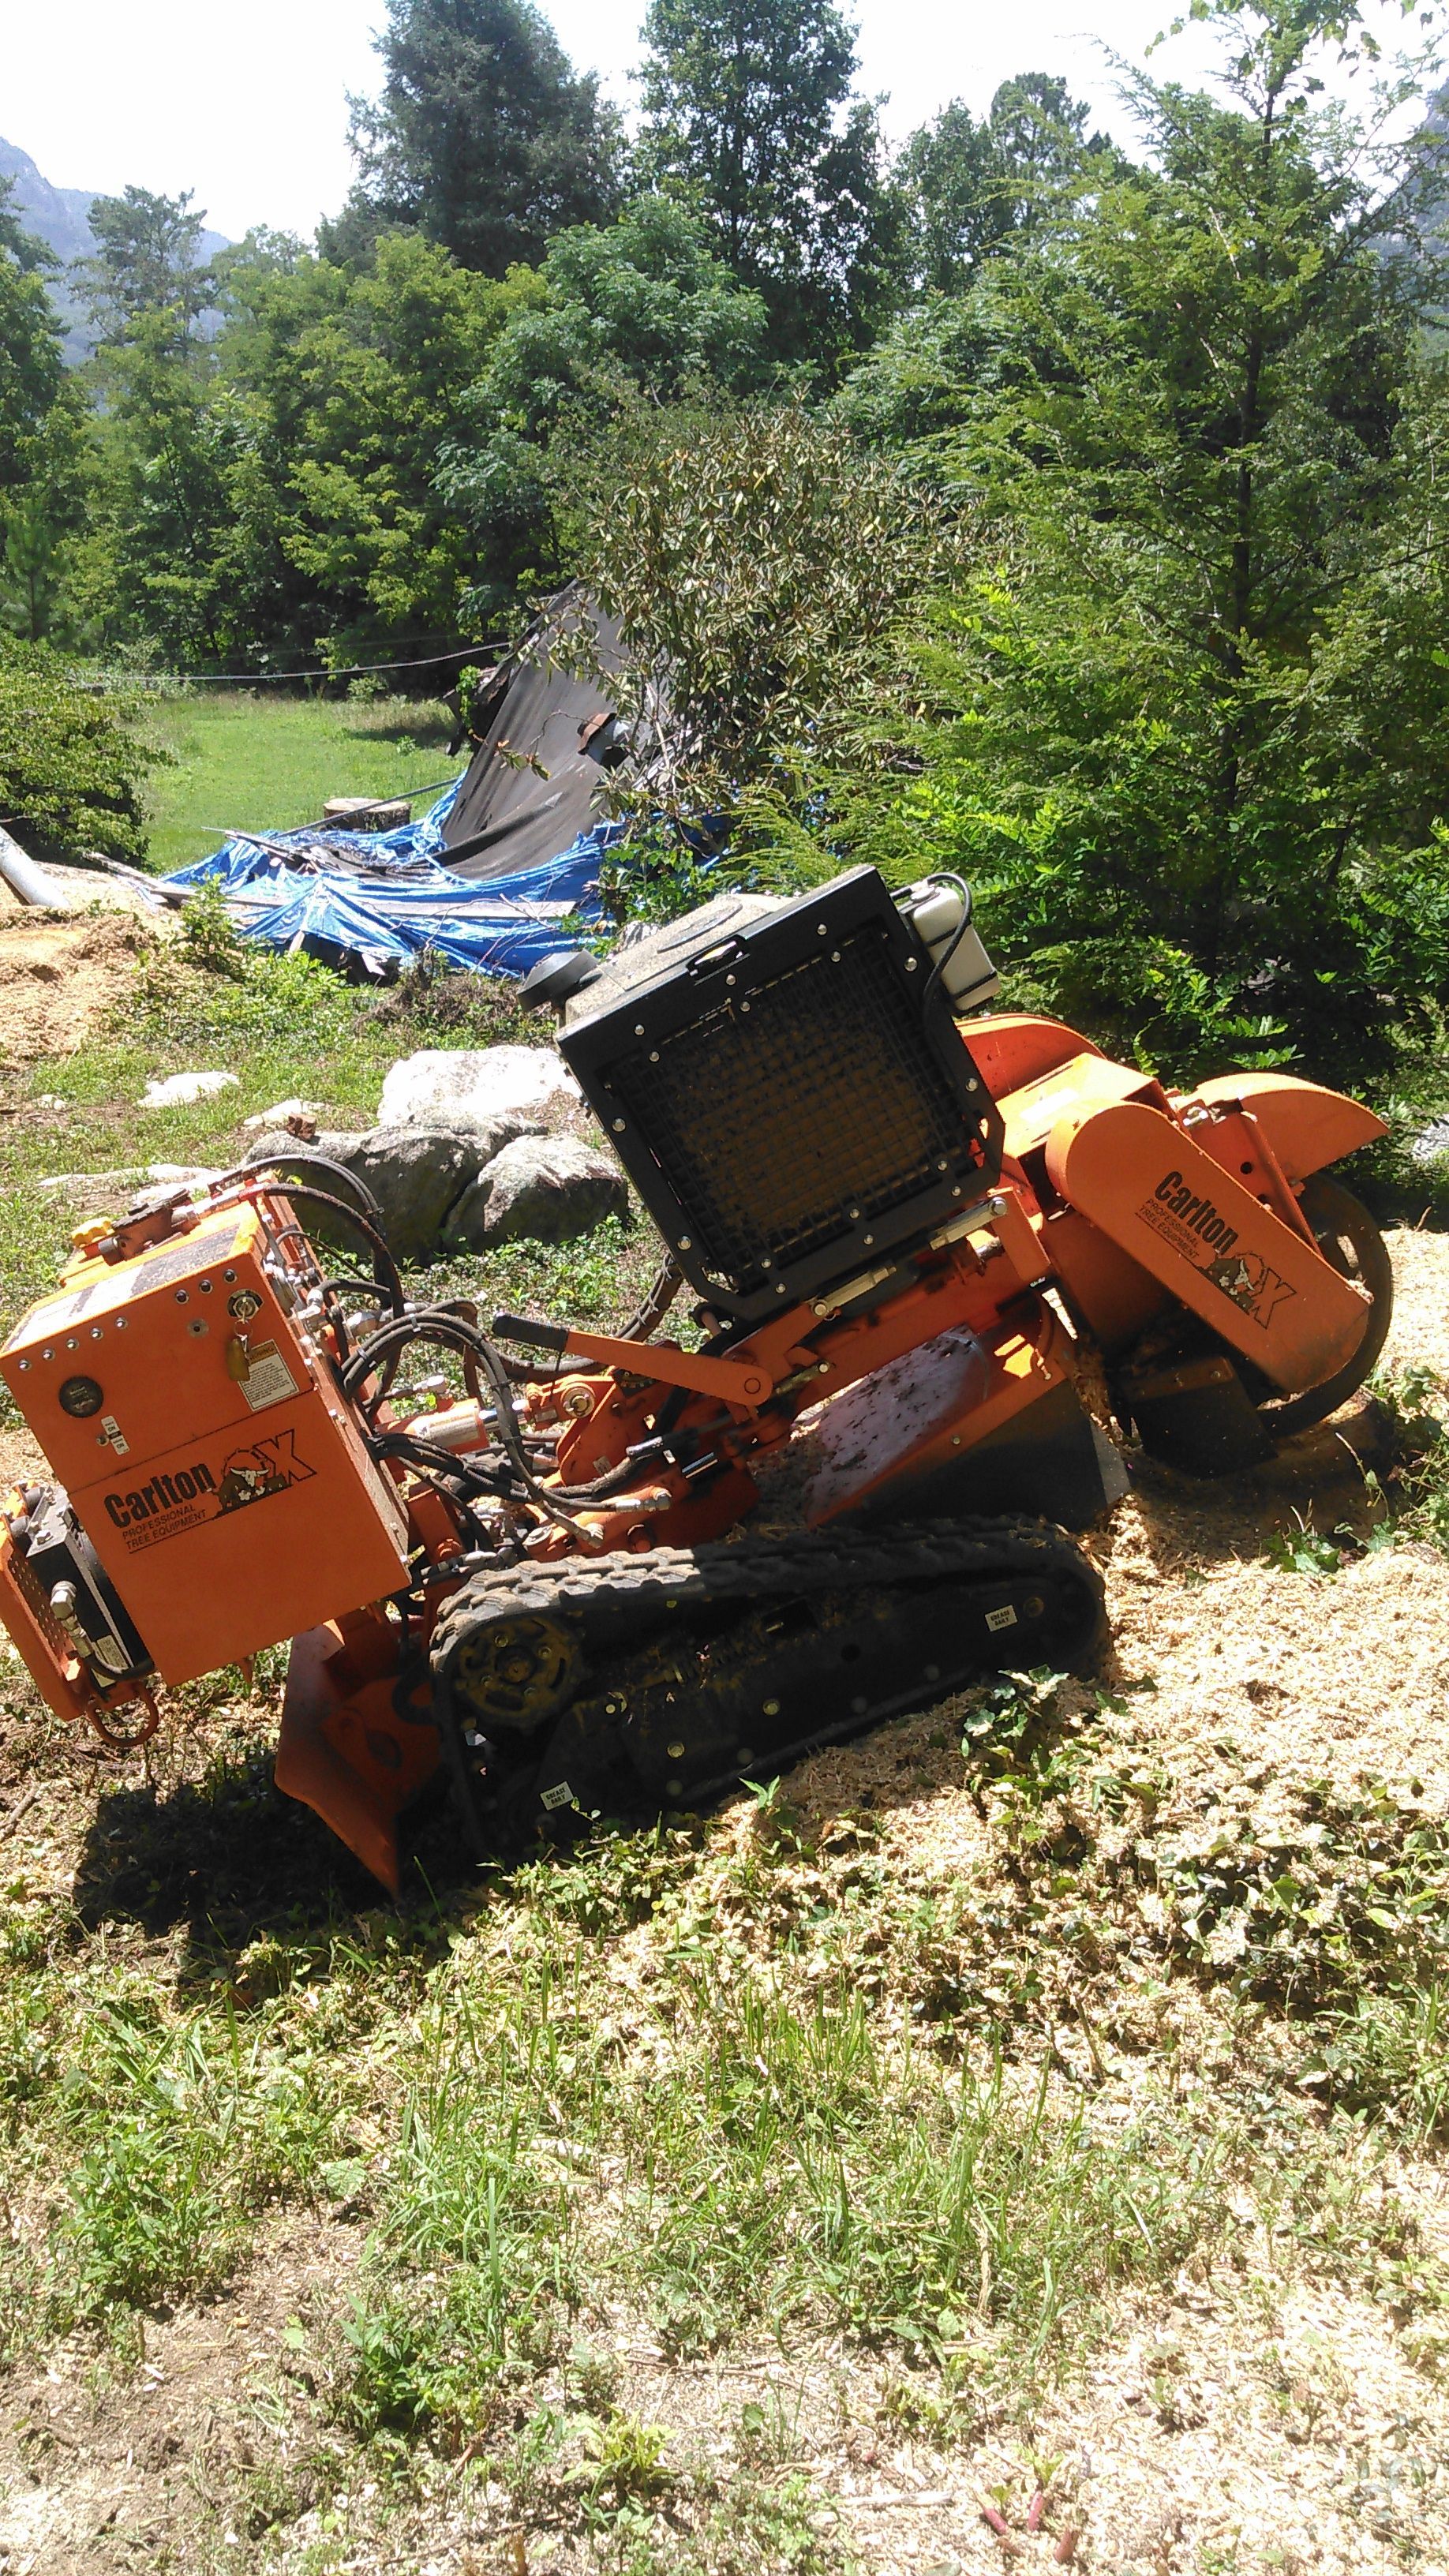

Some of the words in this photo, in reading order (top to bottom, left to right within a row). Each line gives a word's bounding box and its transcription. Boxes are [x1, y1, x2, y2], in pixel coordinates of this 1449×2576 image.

[1139, 1205, 1158, 1224] TREE
[1158, 1222, 1200, 1259] EQUIPMENT
[1145, 1198, 1199, 1248] PROFESSIONAL
[1155, 1171, 1239, 1255] Carlton
[103, 1463, 216, 1528] Carlton
[122, 1504, 196, 1540] PROFESSIONAL
[125, 1534, 151, 1551] TREE
[152, 1510, 207, 1539] EQUIPMENT
[994, 1617, 1009, 1626] DAILY
[551, 1794, 566, 1805] DAILY
